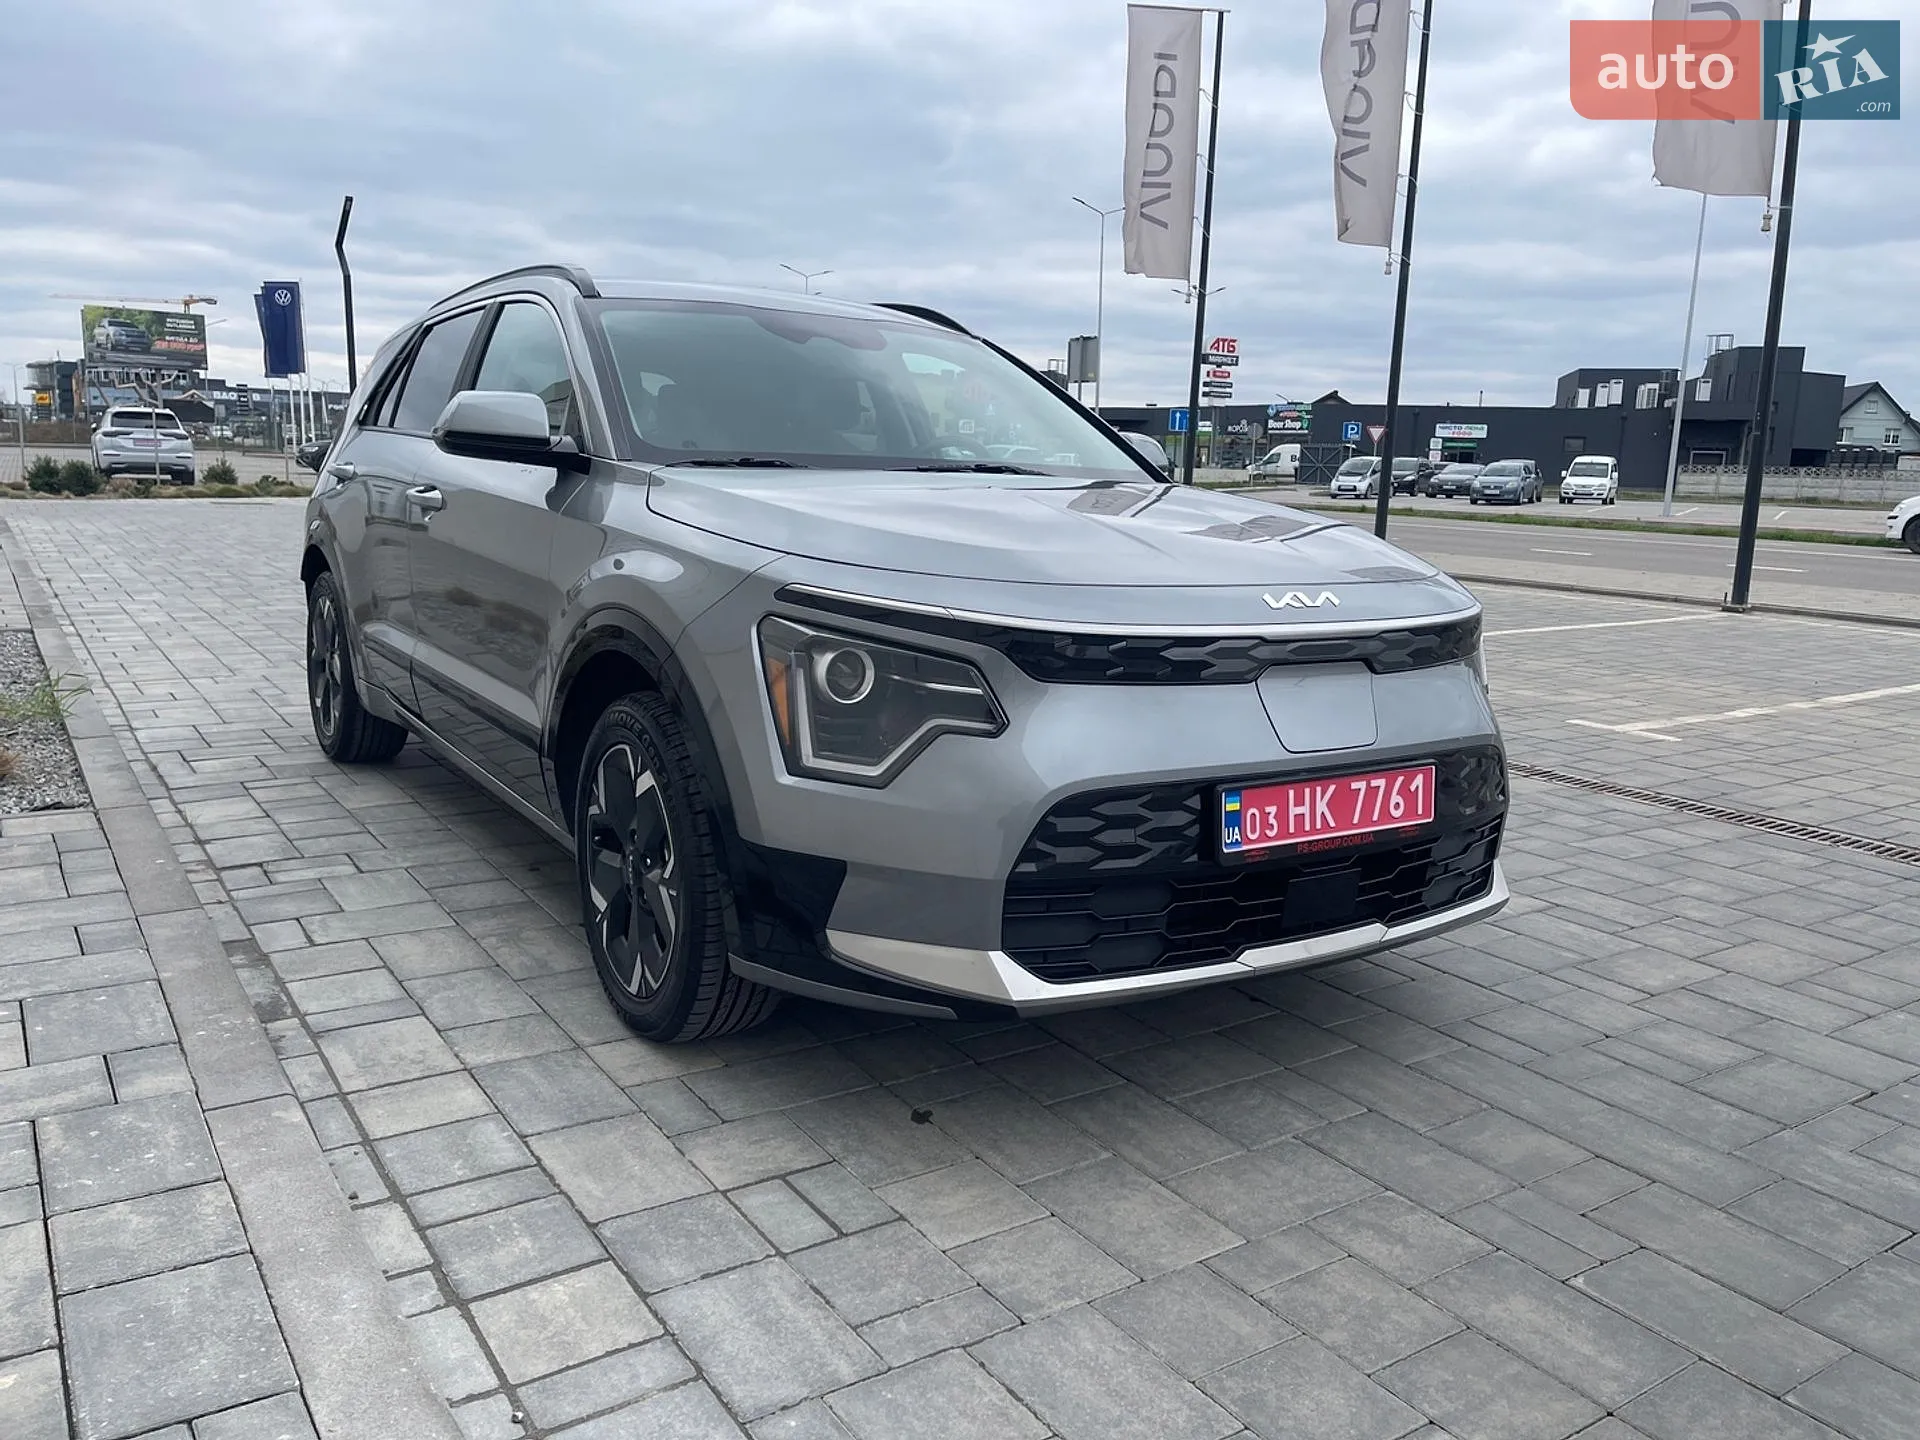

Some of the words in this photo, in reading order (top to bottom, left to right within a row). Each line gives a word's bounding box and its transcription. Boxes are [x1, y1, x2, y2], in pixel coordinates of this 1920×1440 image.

[1268, 419, 1284, 429] Beer
[1284, 419, 1302, 430] Shop
[1261, 591, 1340, 610] KIA
[1245, 805, 1279, 840] 03
[1350, 773, 1424, 825] 7761
[1225, 826, 1242, 844] UA
